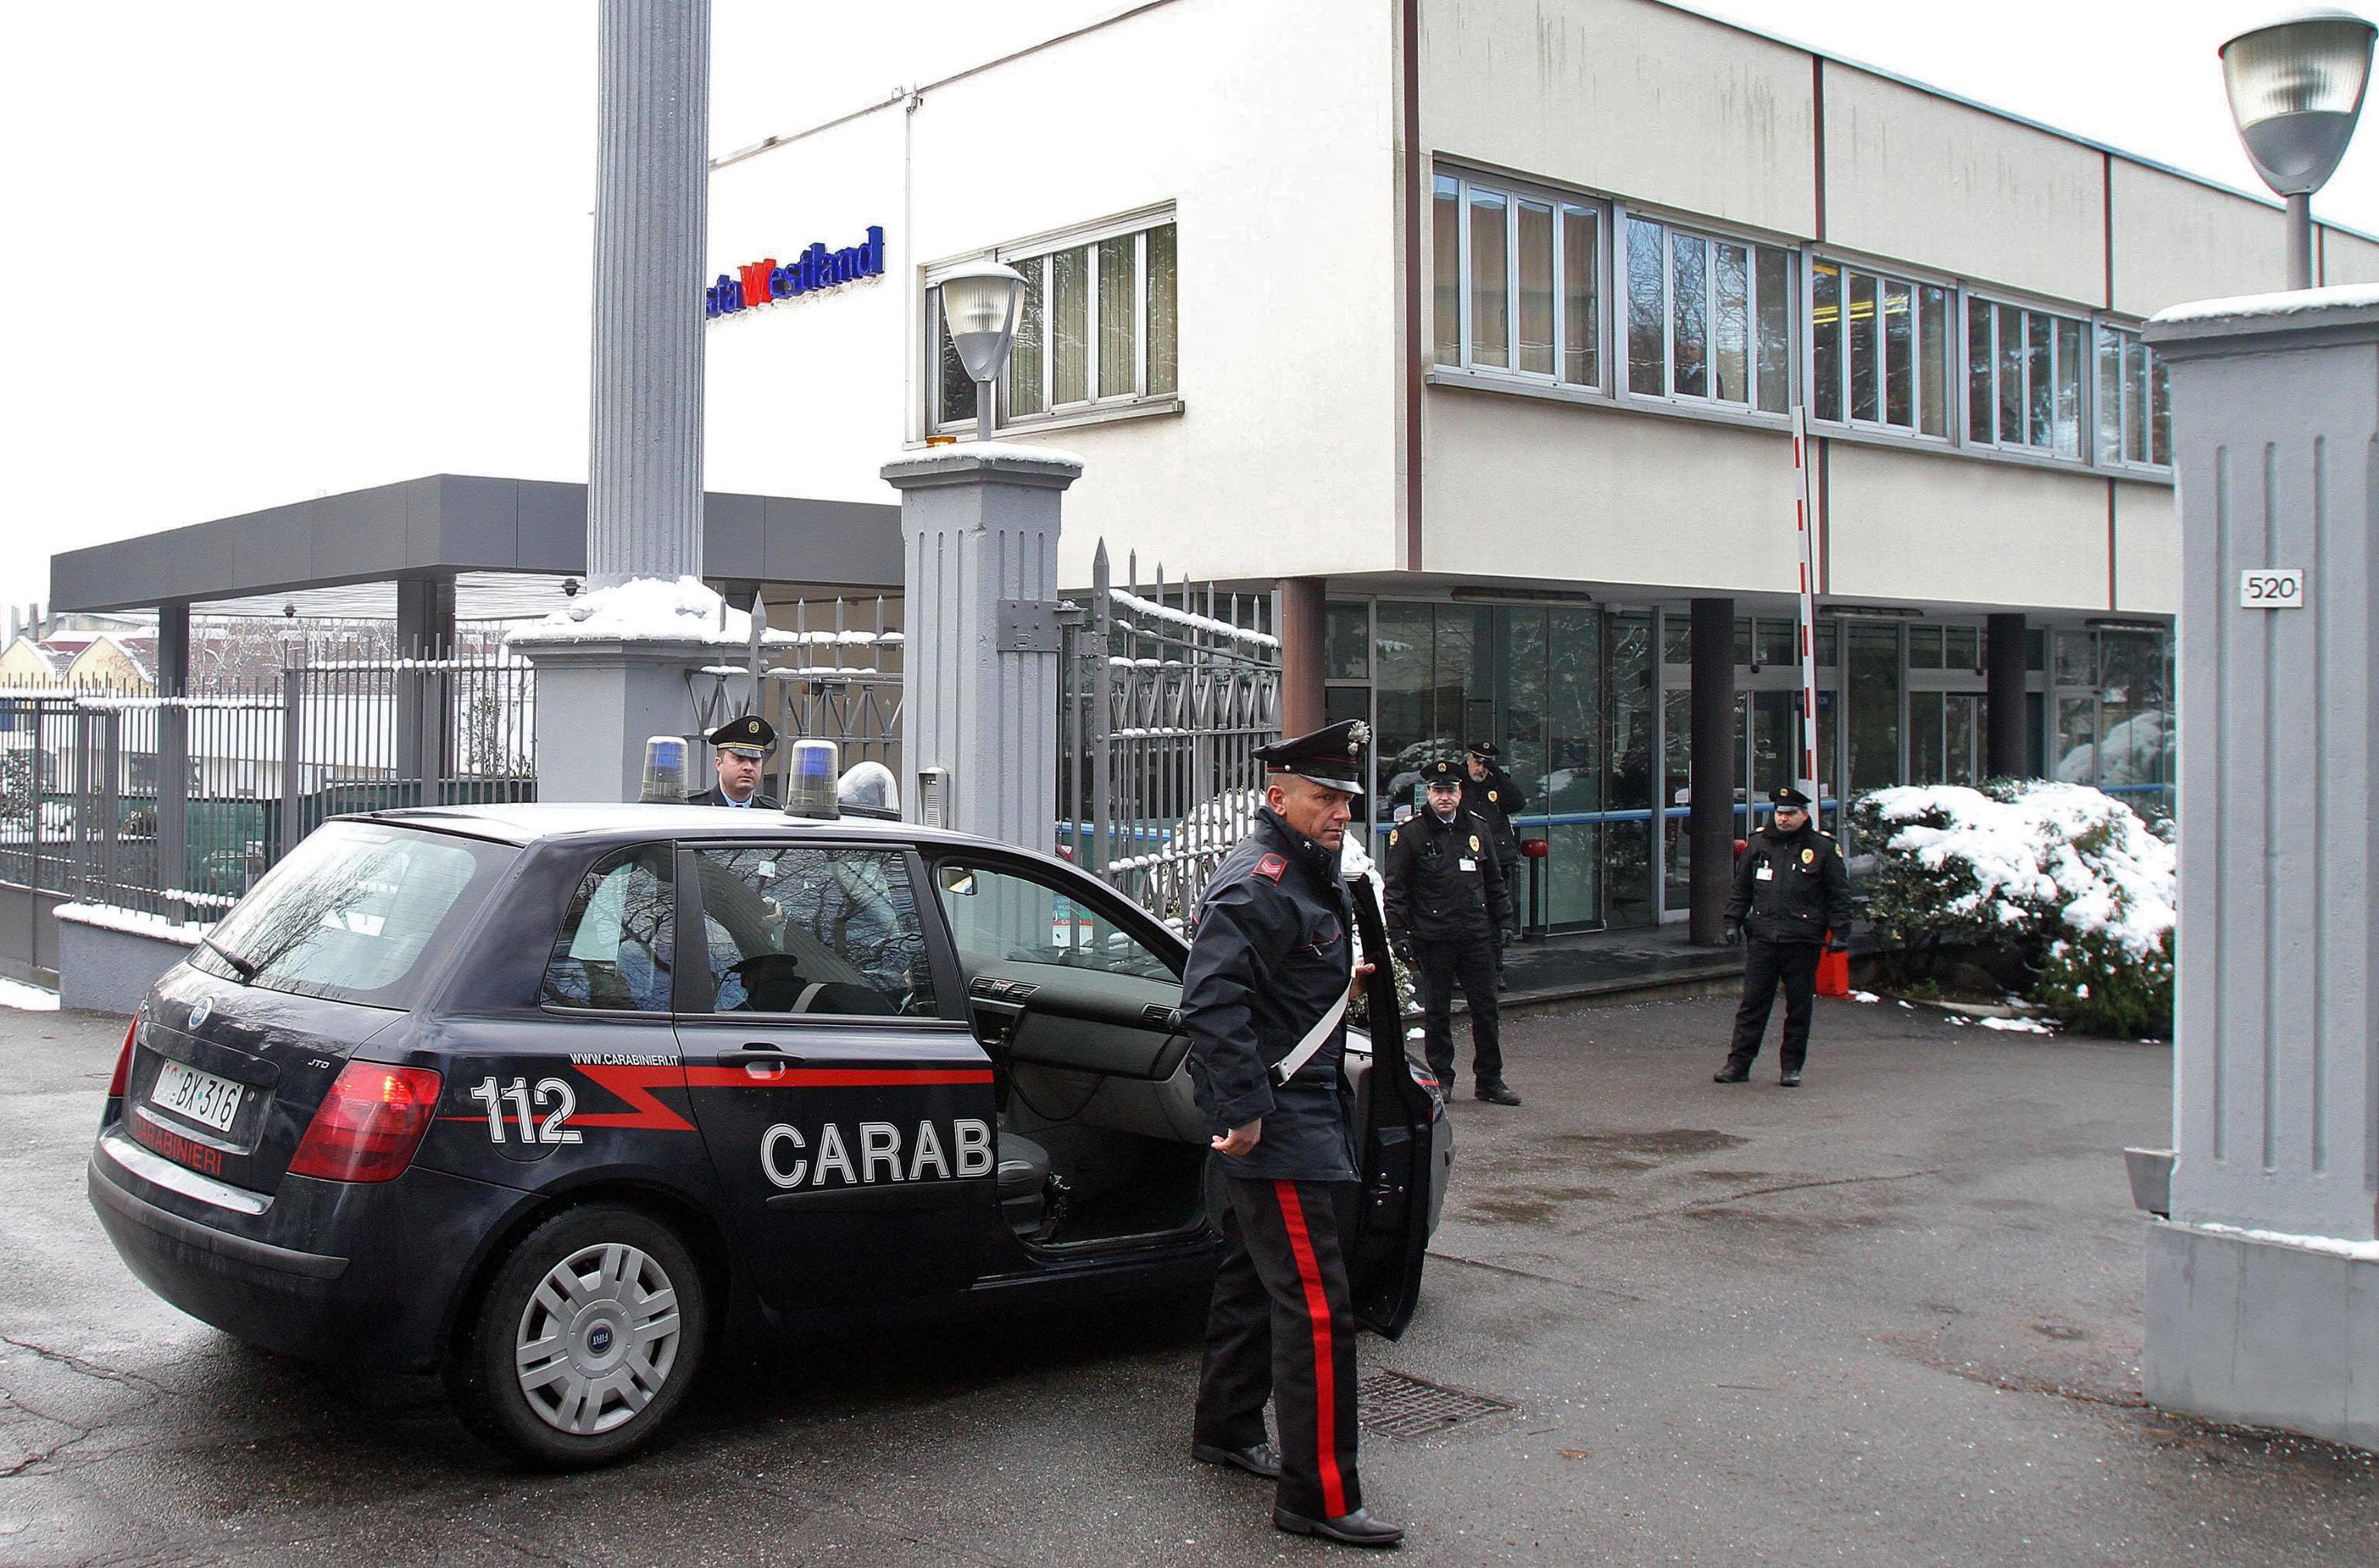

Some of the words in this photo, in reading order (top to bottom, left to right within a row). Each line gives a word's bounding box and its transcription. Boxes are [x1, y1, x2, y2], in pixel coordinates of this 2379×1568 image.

[2248, 577, 2295, 599] 520
[307, 1058, 330, 1069] JTD
[569, 1053, 679, 1067] WWW.CARABINIERI.IT
[176, 1072, 203, 1110] BX
[199, 1079, 237, 1124] 316
[470, 1076, 583, 1144] 112
[135, 1114, 223, 1176] CARABINIERI
[760, 1118, 994, 1189] CARAB
[592, 1333, 608, 1345] FIAT
